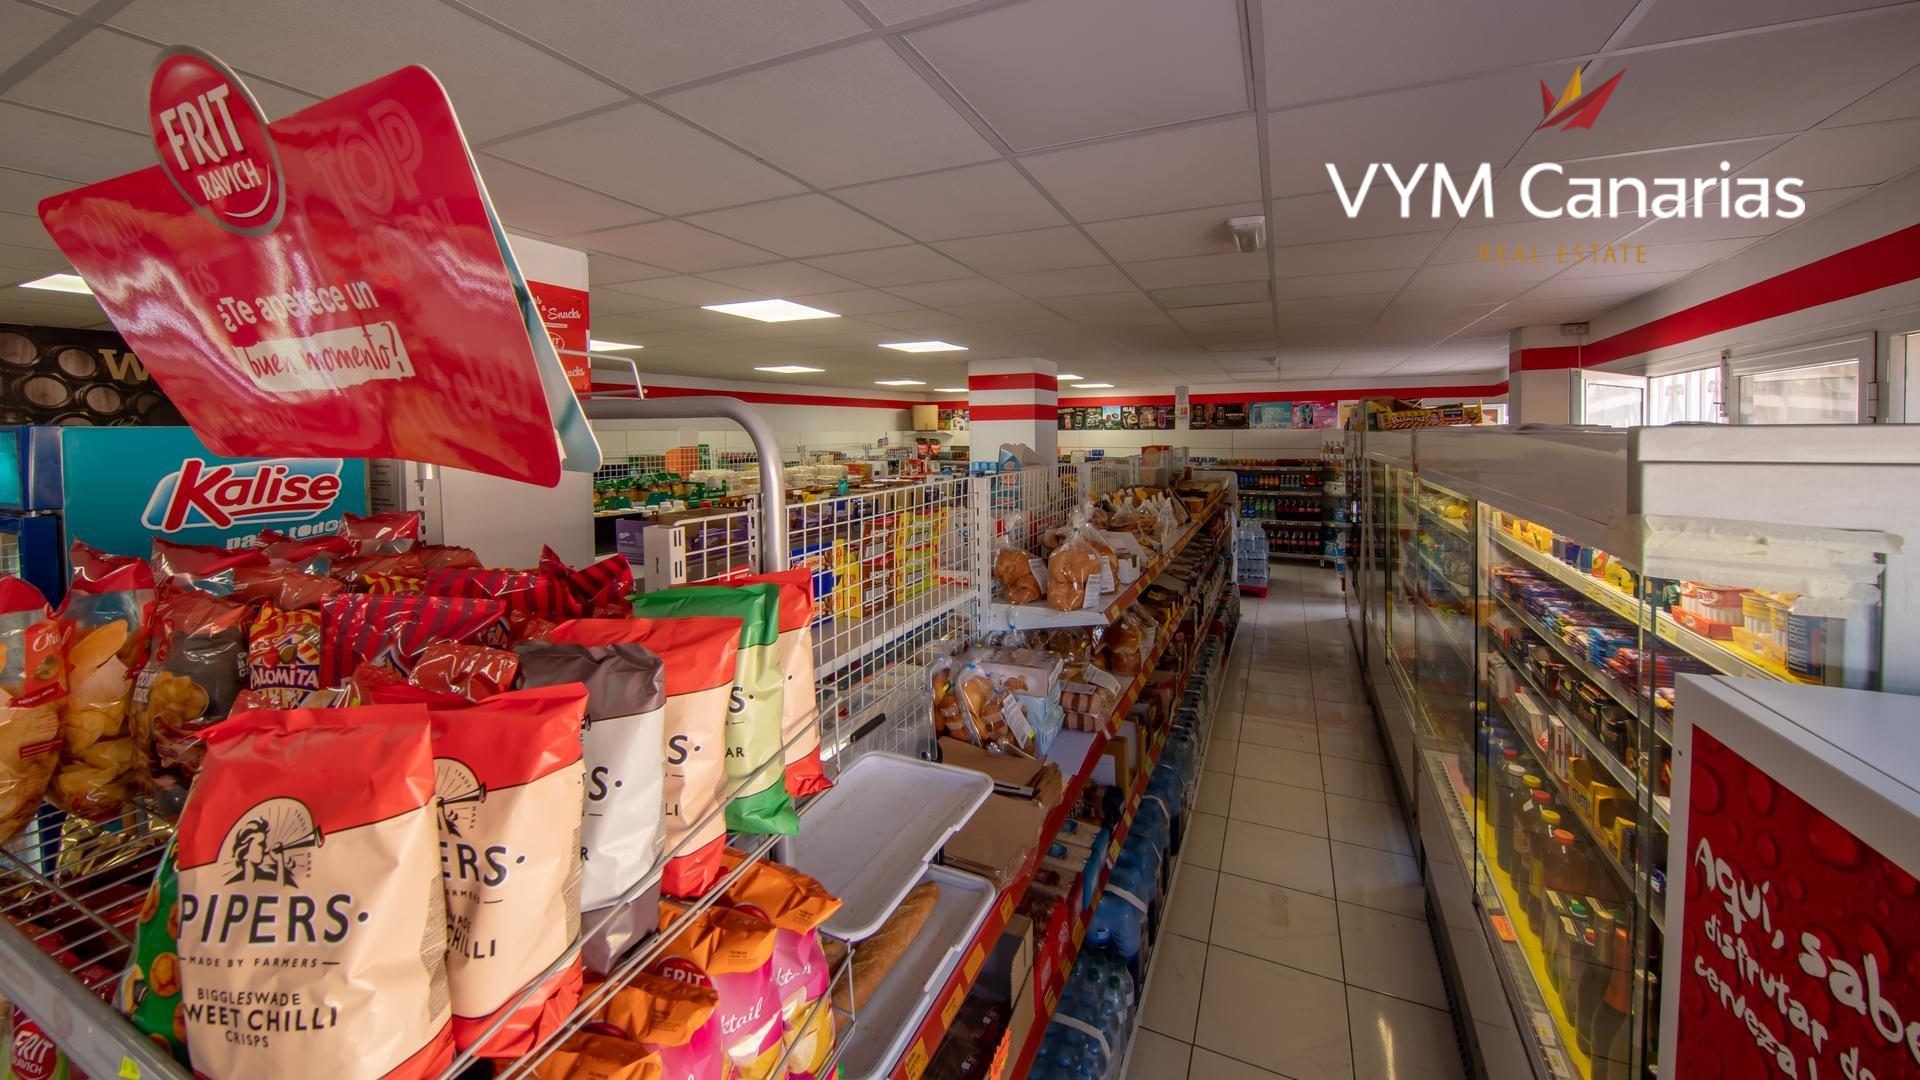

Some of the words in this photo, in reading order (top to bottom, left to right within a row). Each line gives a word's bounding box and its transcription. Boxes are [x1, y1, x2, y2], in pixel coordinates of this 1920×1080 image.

[160, 83, 244, 171] FRIT
[197, 158, 262, 201] RAVICH
[217, 296, 257, 333] ¿Te
[255, 285, 349, 326] apetece
[345, 280, 380, 310] un
[163, 459, 340, 531] Kalise
[288, 519, 340, 540] todo
[189, 956, 220, 967] MADE
[227, 958, 244, 967] BY
[254, 958, 318, 968] FARMERS
[663, 967, 705, 987] FRIT
[197, 987, 302, 1007] BIGGLESWADE
[1705, 913, 1828, 1055] disfrutar
[183, 1003, 241, 1028] WEET
[247, 1007, 338, 1032] CHILLI
[721, 996, 763, 1035] ktail
[1695, 955, 1798, 1080] cerveza
[14, 1030, 54, 1064] FRIT
[225, 1029, 269, 1048] CRISPS
